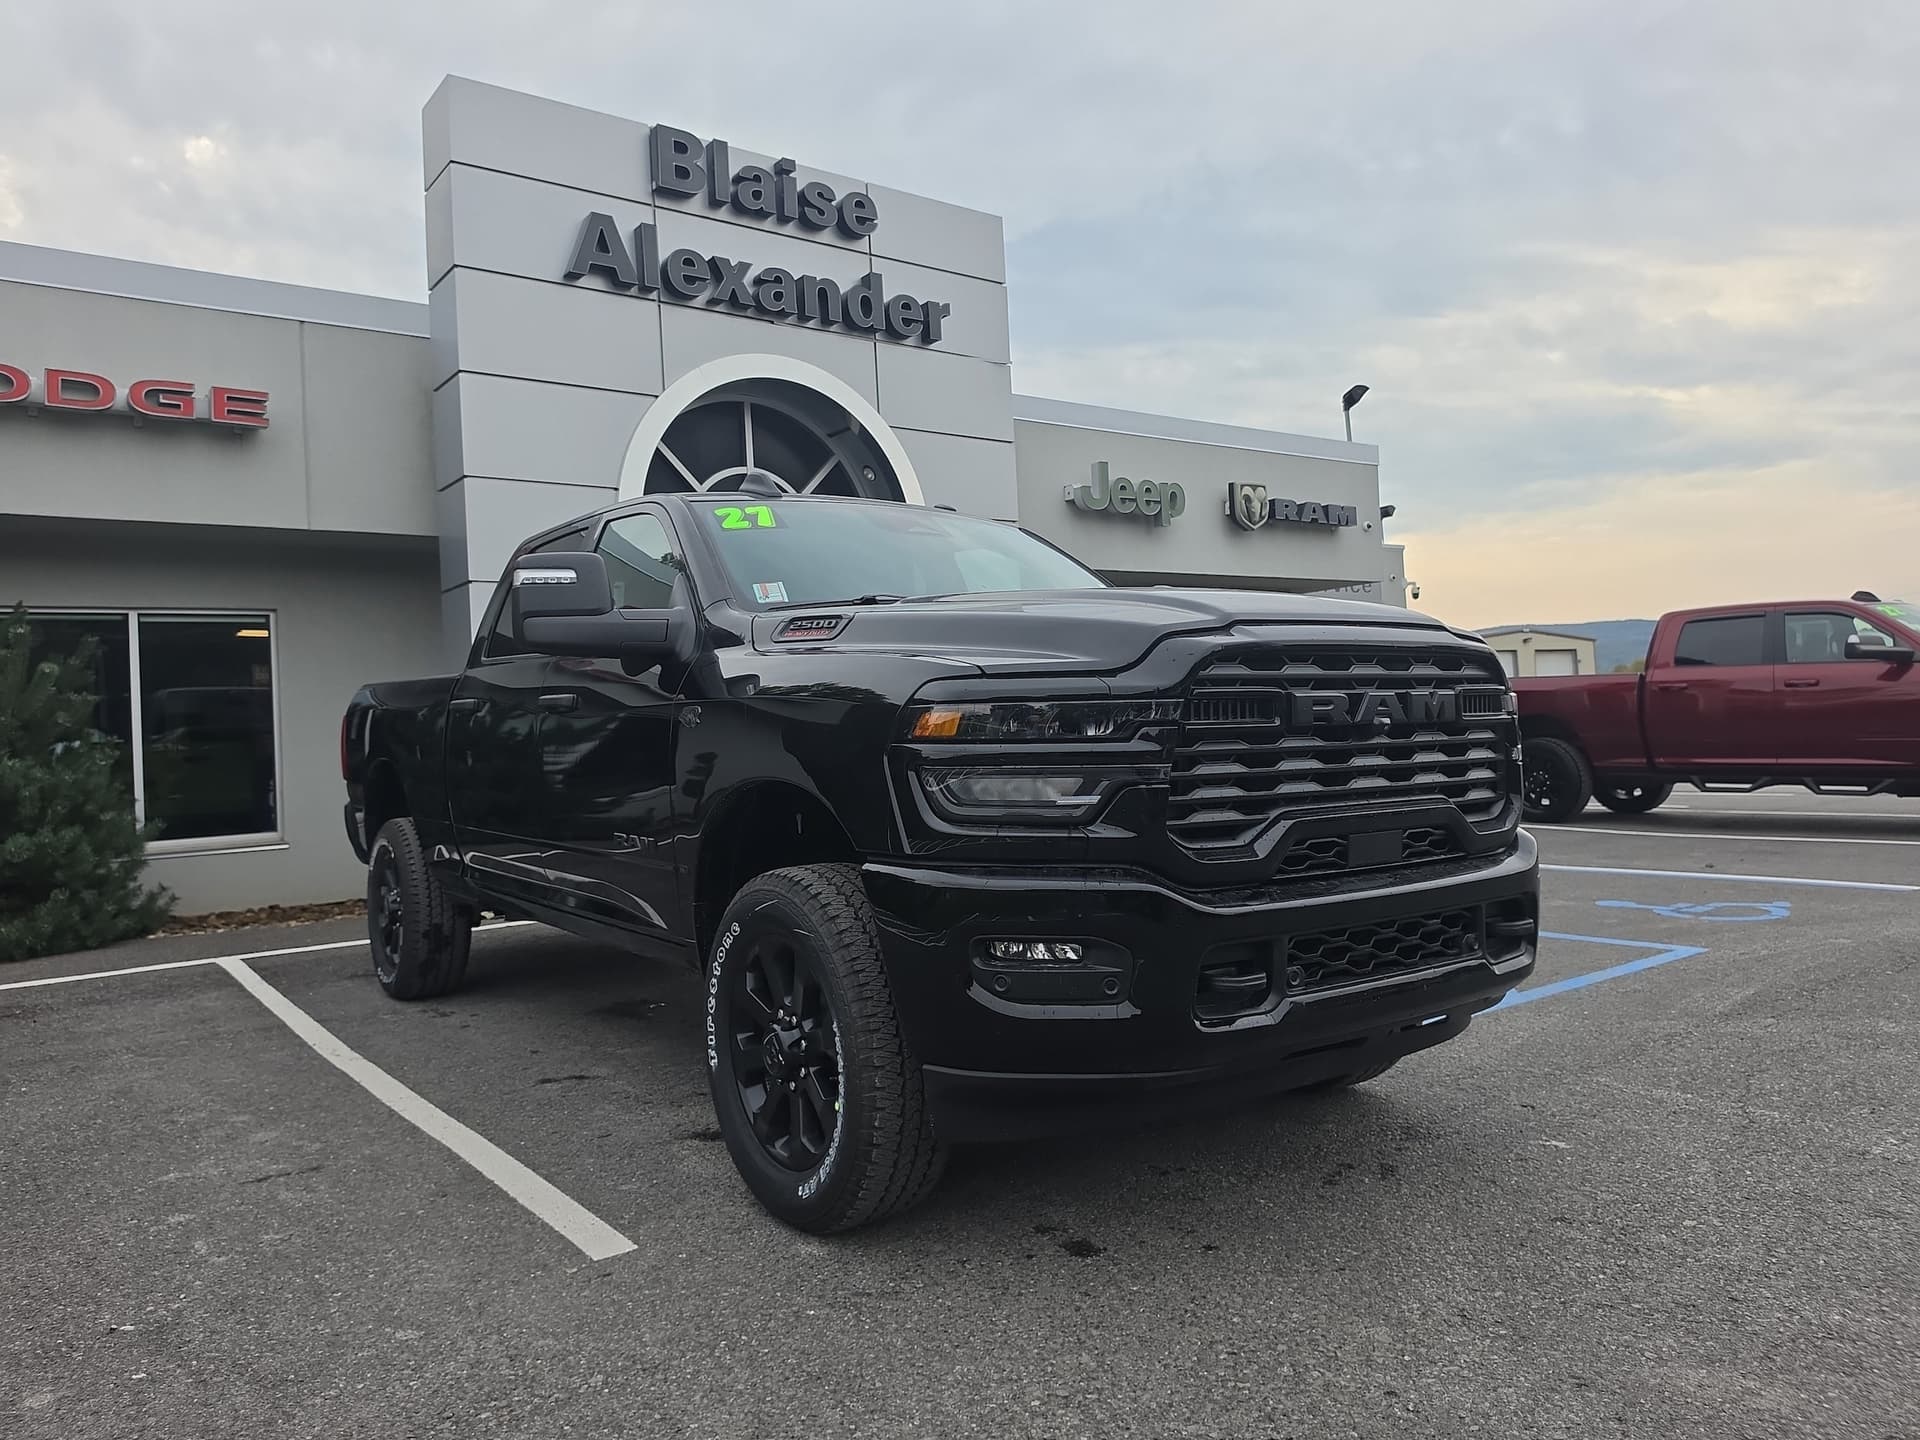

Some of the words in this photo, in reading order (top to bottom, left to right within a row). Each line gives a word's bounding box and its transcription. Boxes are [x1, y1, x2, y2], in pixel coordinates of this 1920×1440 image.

[650, 123, 880, 240] Blaise
[563, 211, 951, 345] Alexander
[1071, 460, 1186, 527] Jeep
[713, 505, 776, 529] 27
[1270, 498, 1357, 527] RAM
[790, 619, 837, 629] 2500
[1292, 689, 1456, 725] RAM
